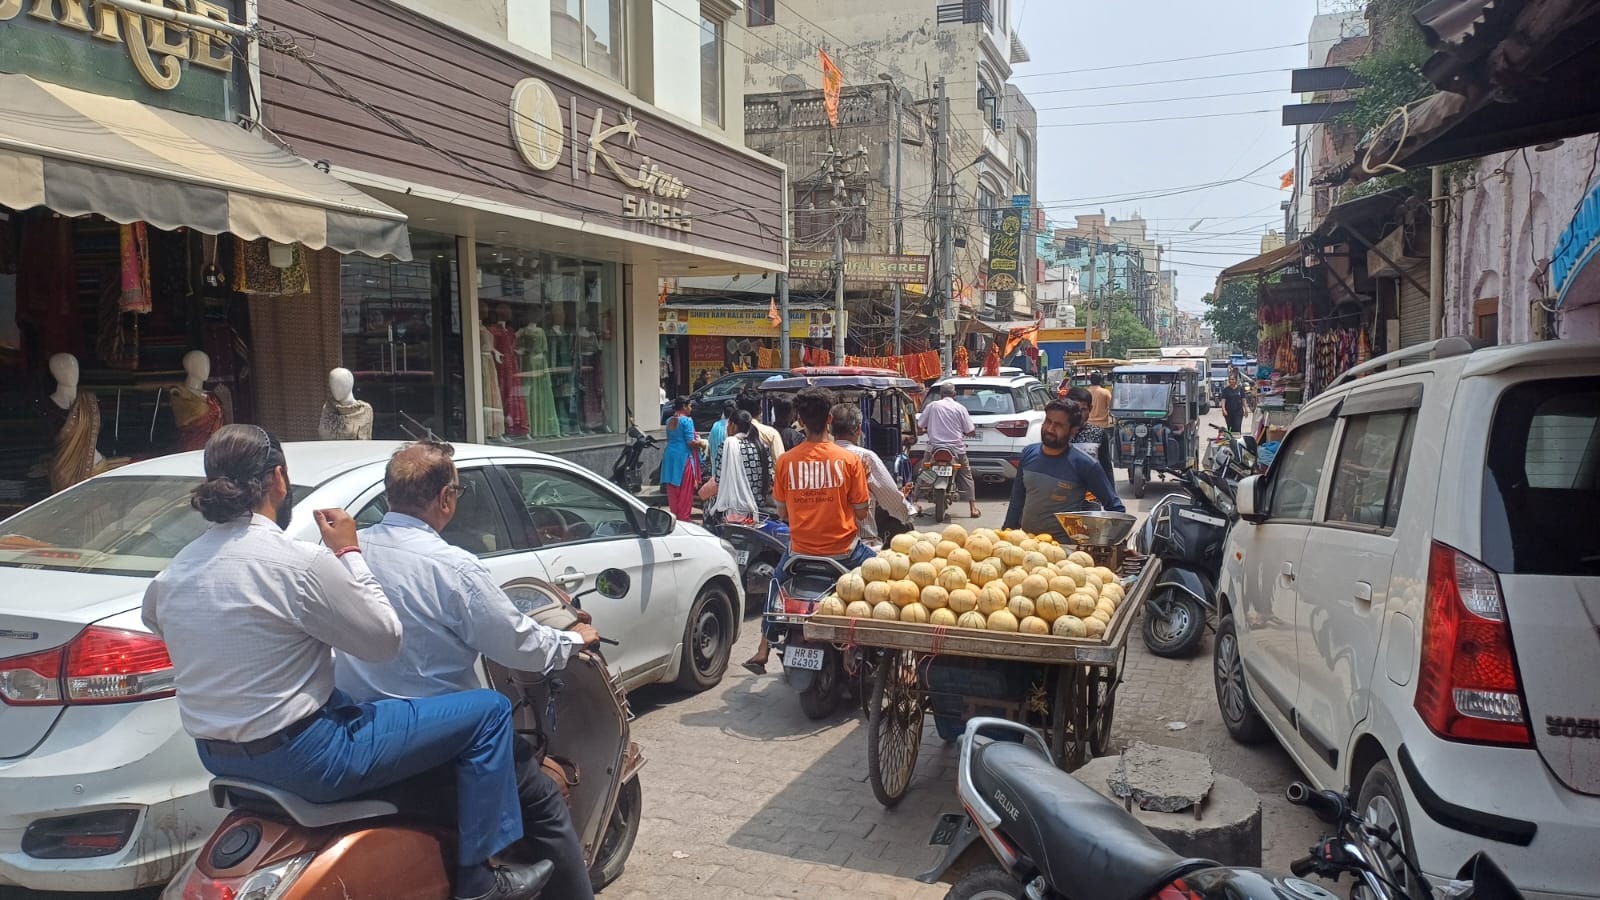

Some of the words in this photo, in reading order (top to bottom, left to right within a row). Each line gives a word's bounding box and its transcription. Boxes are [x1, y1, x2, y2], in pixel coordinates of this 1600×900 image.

[622, 194, 692, 232] SAREES
[880, 262, 927, 272] SAREE
[794, 649, 806, 658] HR
[808, 651, 819, 659] 85
[791, 658, 819, 668] G4302
[994, 790, 1020, 821] DELUXE
